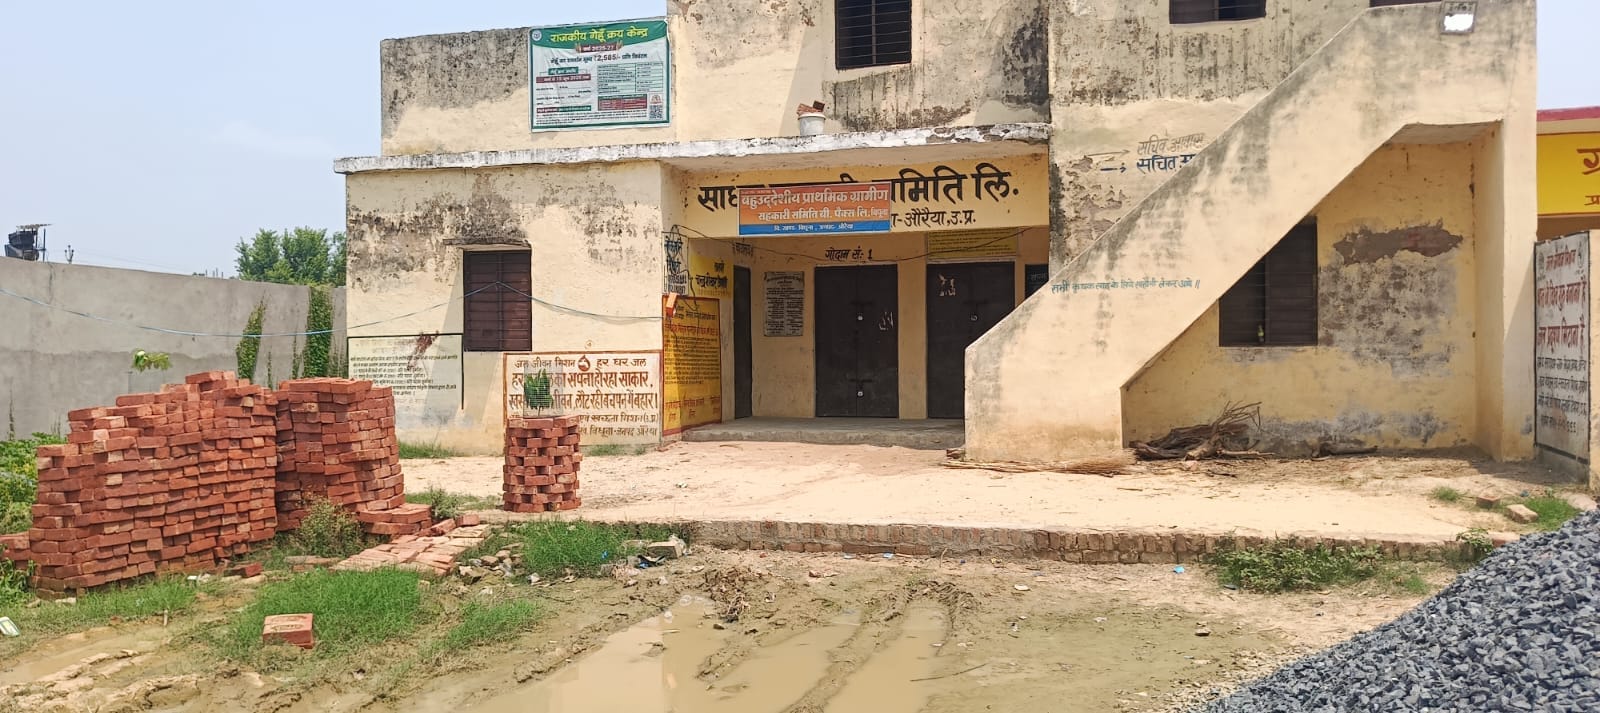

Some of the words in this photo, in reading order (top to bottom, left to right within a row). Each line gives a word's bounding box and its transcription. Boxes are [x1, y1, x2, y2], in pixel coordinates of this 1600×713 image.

[551, 30, 586, 42] राजकीय
[589, 28, 606, 42] गेहूँ
[607, 29, 623, 39] क्रय
[627, 26, 648, 39] केन्द्र
[971, 162, 1019, 202] लि.
[803, 188, 848, 205] प्राथमिक
[850, 186, 888, 203] ग्रामीण
[758, 208, 790, 221] सहकारी
[792, 206, 818, 220] समिति
[825, 246, 851, 261] गोदाम
[514, 359, 529, 369] जल
[531, 356, 552, 368] जीवन
[555, 356, 576, 368] मिशन
[597, 358, 610, 368] हर
[613, 358, 629, 367] घर
[631, 358, 647, 367] जल
[567, 371, 593, 388] सपना
[594, 368, 603, 389] हो
[603, 372, 617, 389] रहा
[590, 388, 602, 409] रही
[603, 393, 627, 409] बचपन
[590, 414, 619, 424] स्वच्छता
[620, 411, 643, 424] मिशन
